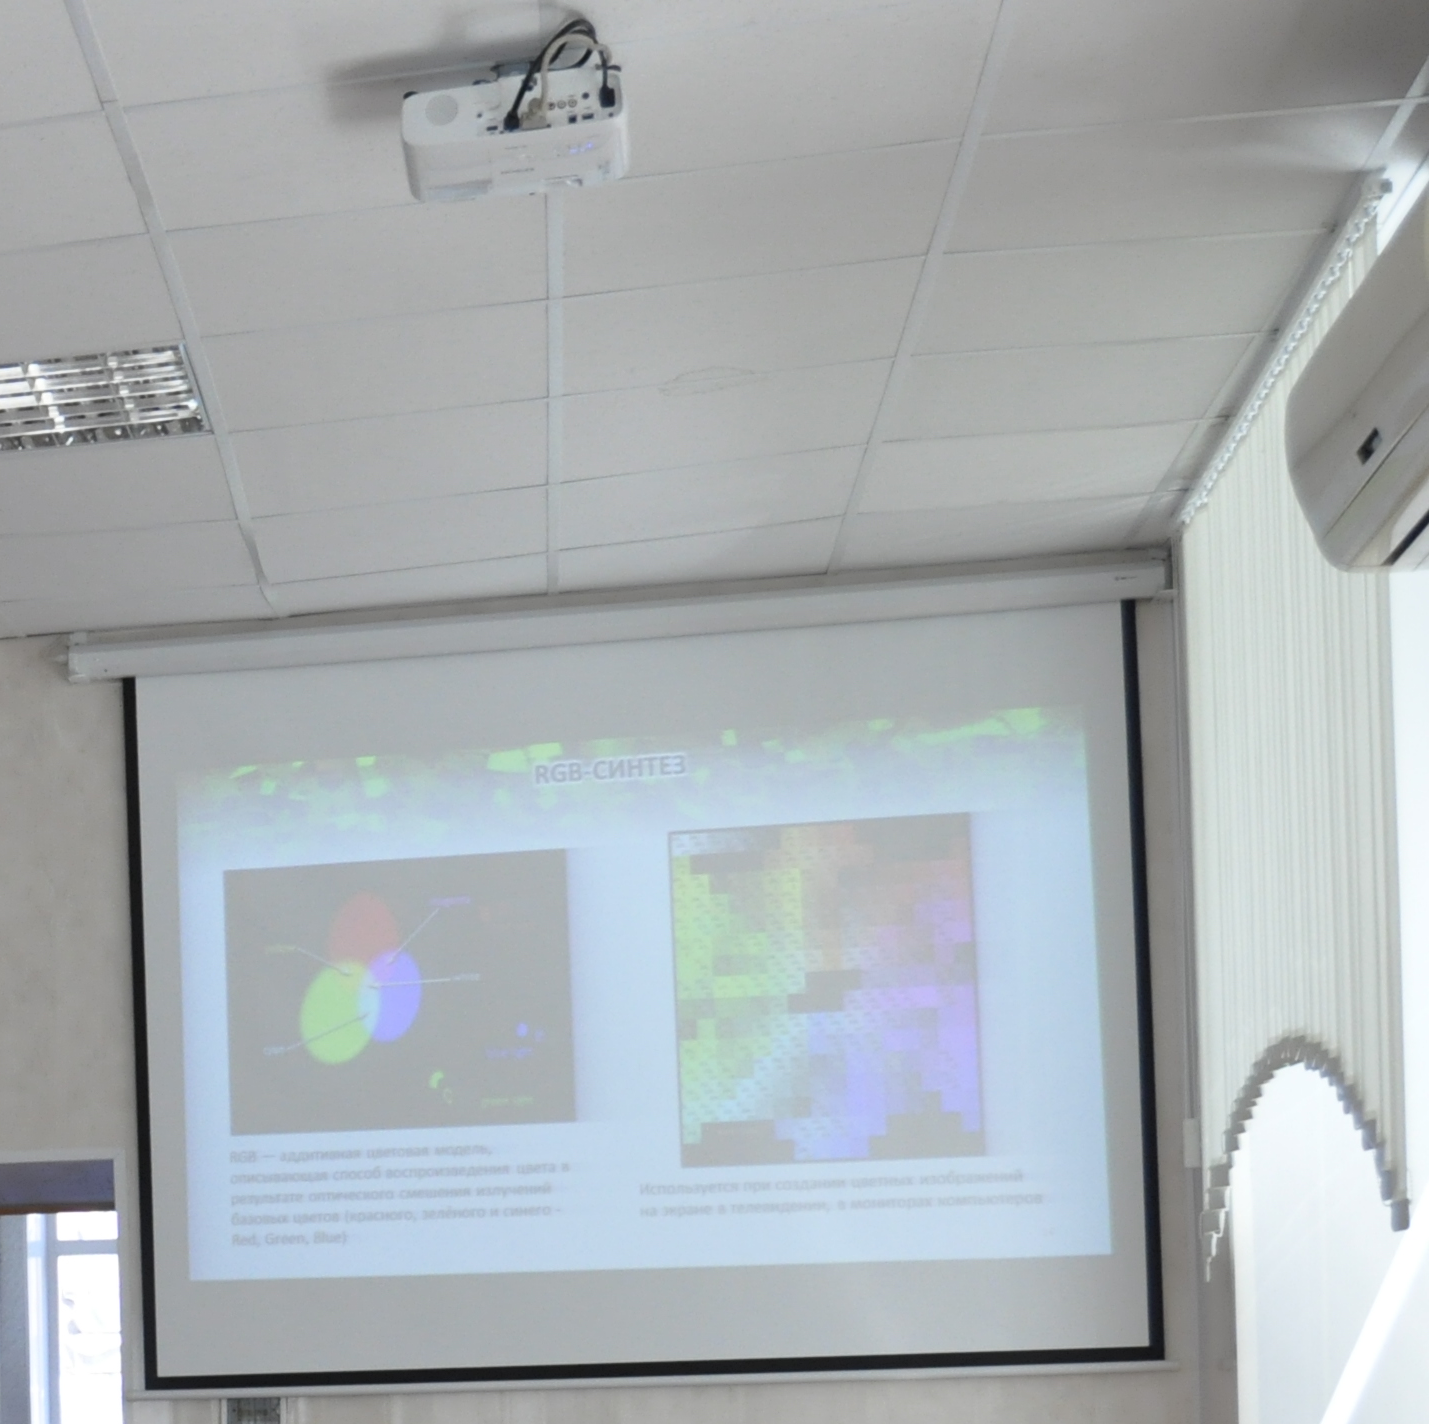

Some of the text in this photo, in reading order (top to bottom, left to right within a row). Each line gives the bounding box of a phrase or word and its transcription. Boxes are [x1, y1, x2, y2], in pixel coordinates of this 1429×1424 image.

[534, 754, 687, 785] RGB-СИНТЕЗ
[229, 1150, 258, 1163] RGB
[279, 1149, 361, 1164] аддитивная
[366, 1146, 429, 1161] цветовая
[434, 1143, 493, 1157] модель,
[230, 1170, 329, 1185] описывающая
[332, 1165, 382, 1181] способ
[386, 1163, 510, 1180] воспроизведения
[516, 1161, 556, 1175] цвета
[230, 1191, 304, 1207] результате
[308, 1189, 395, 1203] оптического
[475, 1181, 553, 1198] излучений
[638, 1181, 739, 1197] Используется
[743, 1180, 771, 1194] при
[850, 1174, 914, 1190] цветных
[231, 1212, 289, 1227] базовых
[292, 1211, 340, 1226] цветов
[489, 1207, 499, 1217] и
[502, 1205, 552, 1217] синего
[639, 1206, 658, 1218] на
[662, 1202, 712, 1218] экране
[231, 1232, 261, 1248] Red,
[264, 1231, 310, 1246] Green,
